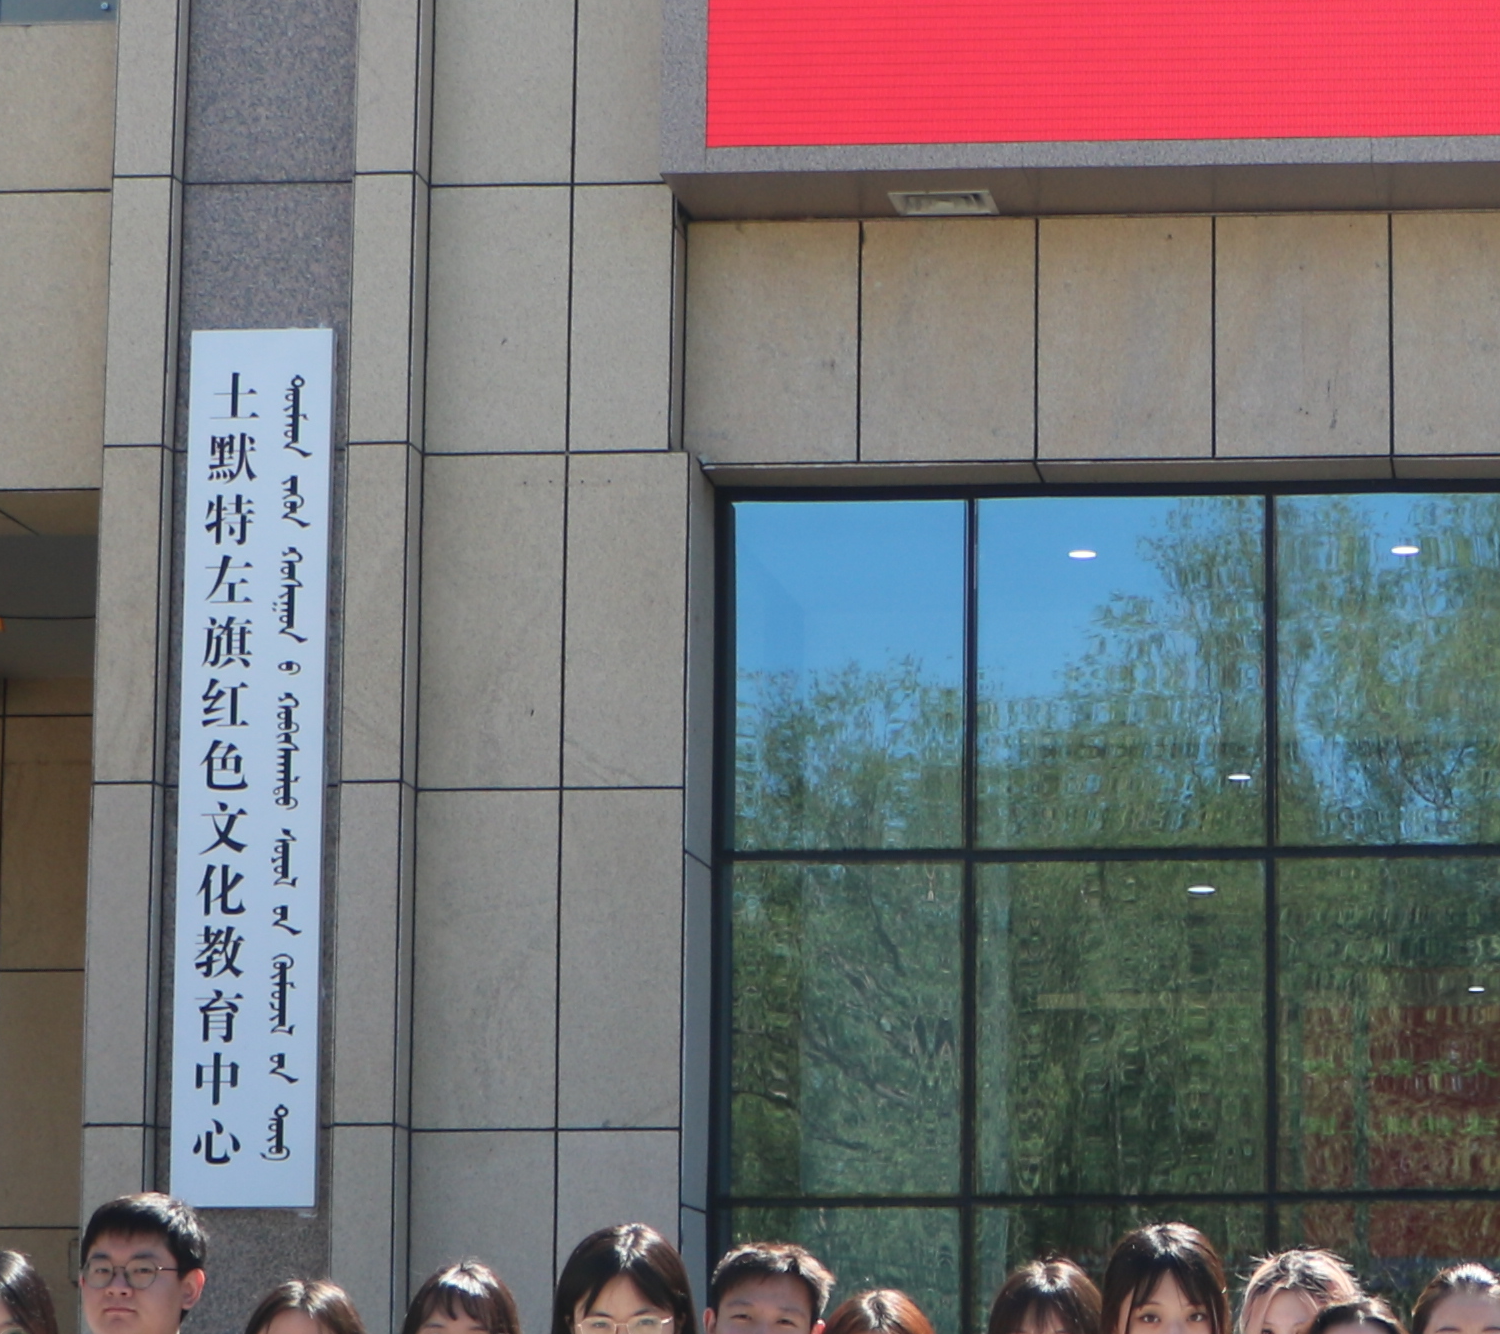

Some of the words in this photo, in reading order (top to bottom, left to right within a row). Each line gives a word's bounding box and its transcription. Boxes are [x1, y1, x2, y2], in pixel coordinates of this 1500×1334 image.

[192, 371, 260, 1165] 土默特左旗红色文化教育中心
